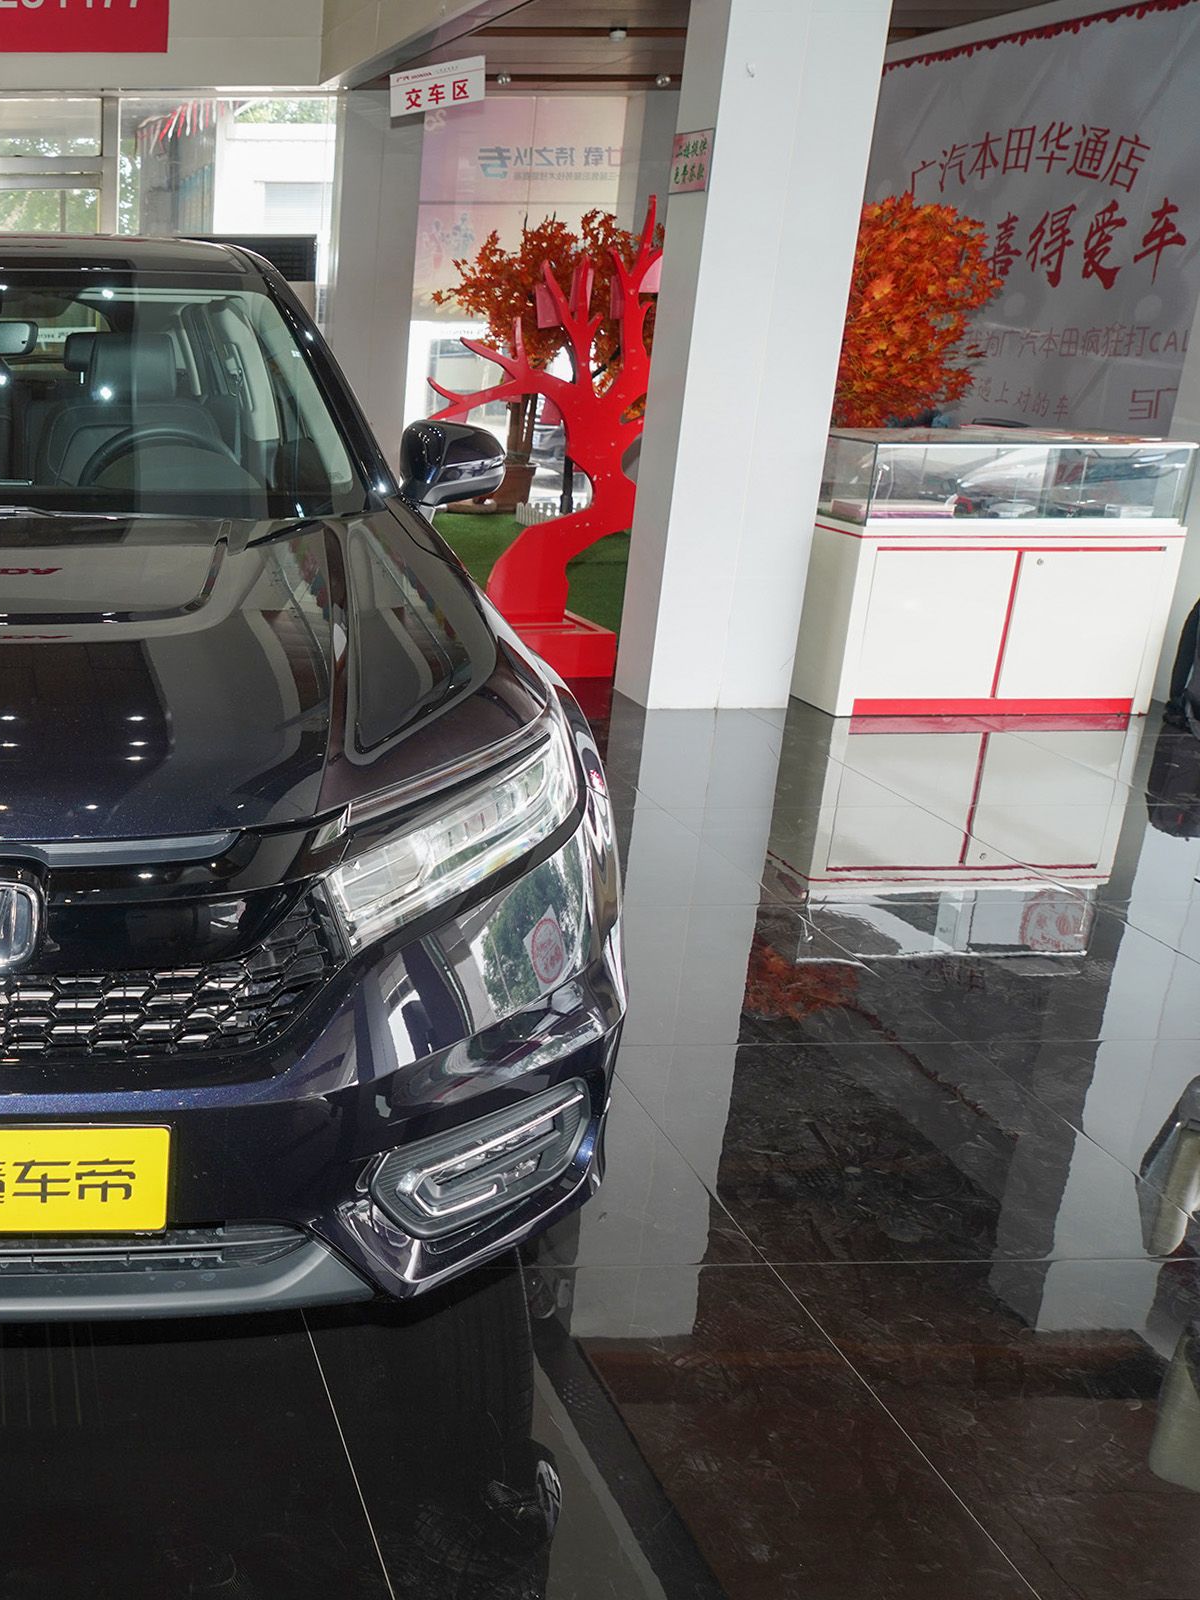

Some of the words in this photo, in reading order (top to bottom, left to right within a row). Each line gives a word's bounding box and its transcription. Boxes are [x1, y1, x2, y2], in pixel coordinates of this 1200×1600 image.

[405, 78, 469, 111] 交车区
[910, 121, 1151, 194] 广汽本田华通店
[983, 197, 1187, 290] 喜得爱车
